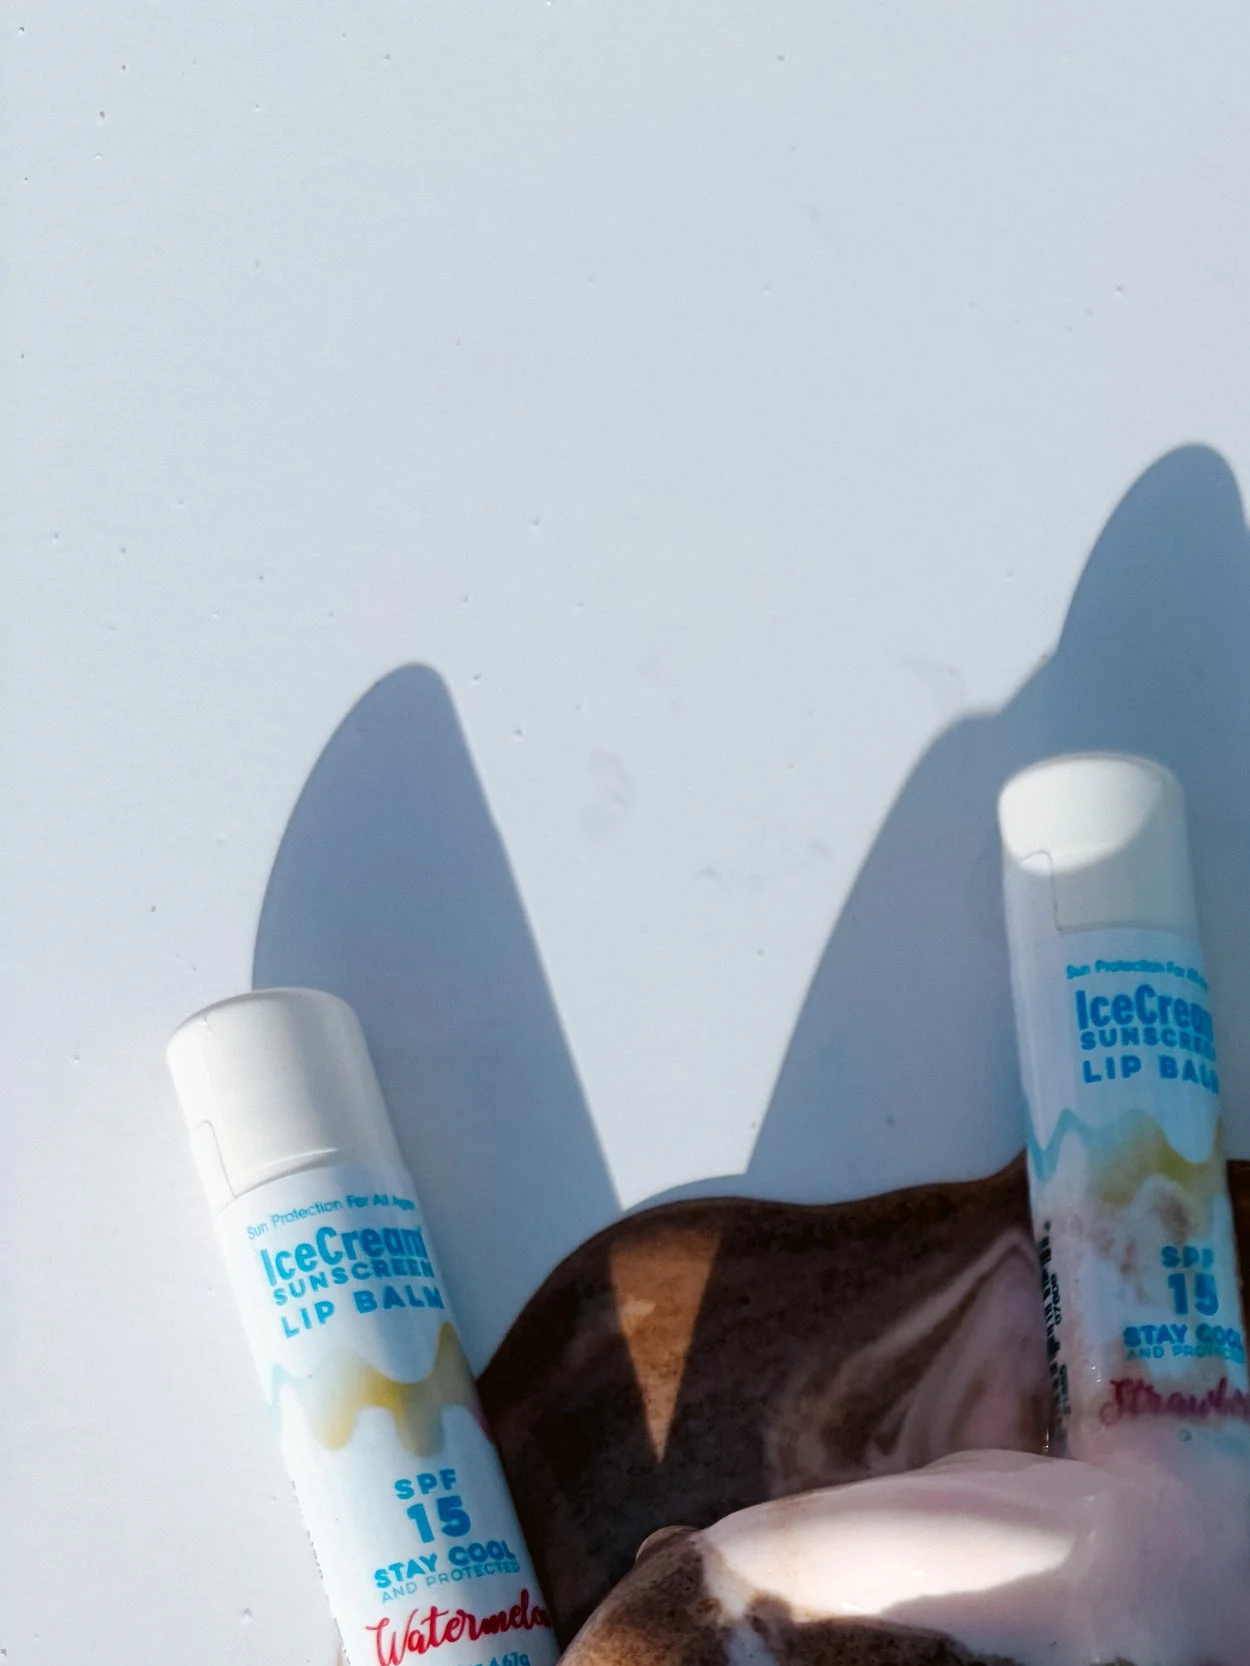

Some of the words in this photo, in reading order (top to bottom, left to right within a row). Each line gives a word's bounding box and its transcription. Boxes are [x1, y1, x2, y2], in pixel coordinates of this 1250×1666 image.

[1082, 1053, 1142, 1084] LIP
[246, 1221, 269, 1241] Sun
[270, 1199, 343, 1229] Protection
[259, 1226, 429, 1287] IceCream
[272, 1257, 435, 1307] SUNSCREEN
[1167, 1271, 1220, 1318] 15
[280, 1300, 335, 1339] LIP
[356, 1284, 445, 1315] BALM
[1122, 1323, 1189, 1348] STAY
[1126, 1344, 1165, 1360] AND
[393, 1468, 458, 1500] SPF
[406, 1495, 471, 1545] 15
[374, 1553, 438, 1589] STAY
[448, 1540, 516, 1566] COOL
[381, 1581, 418, 1604] AND
[425, 1560, 521, 1588] PROTECTED
